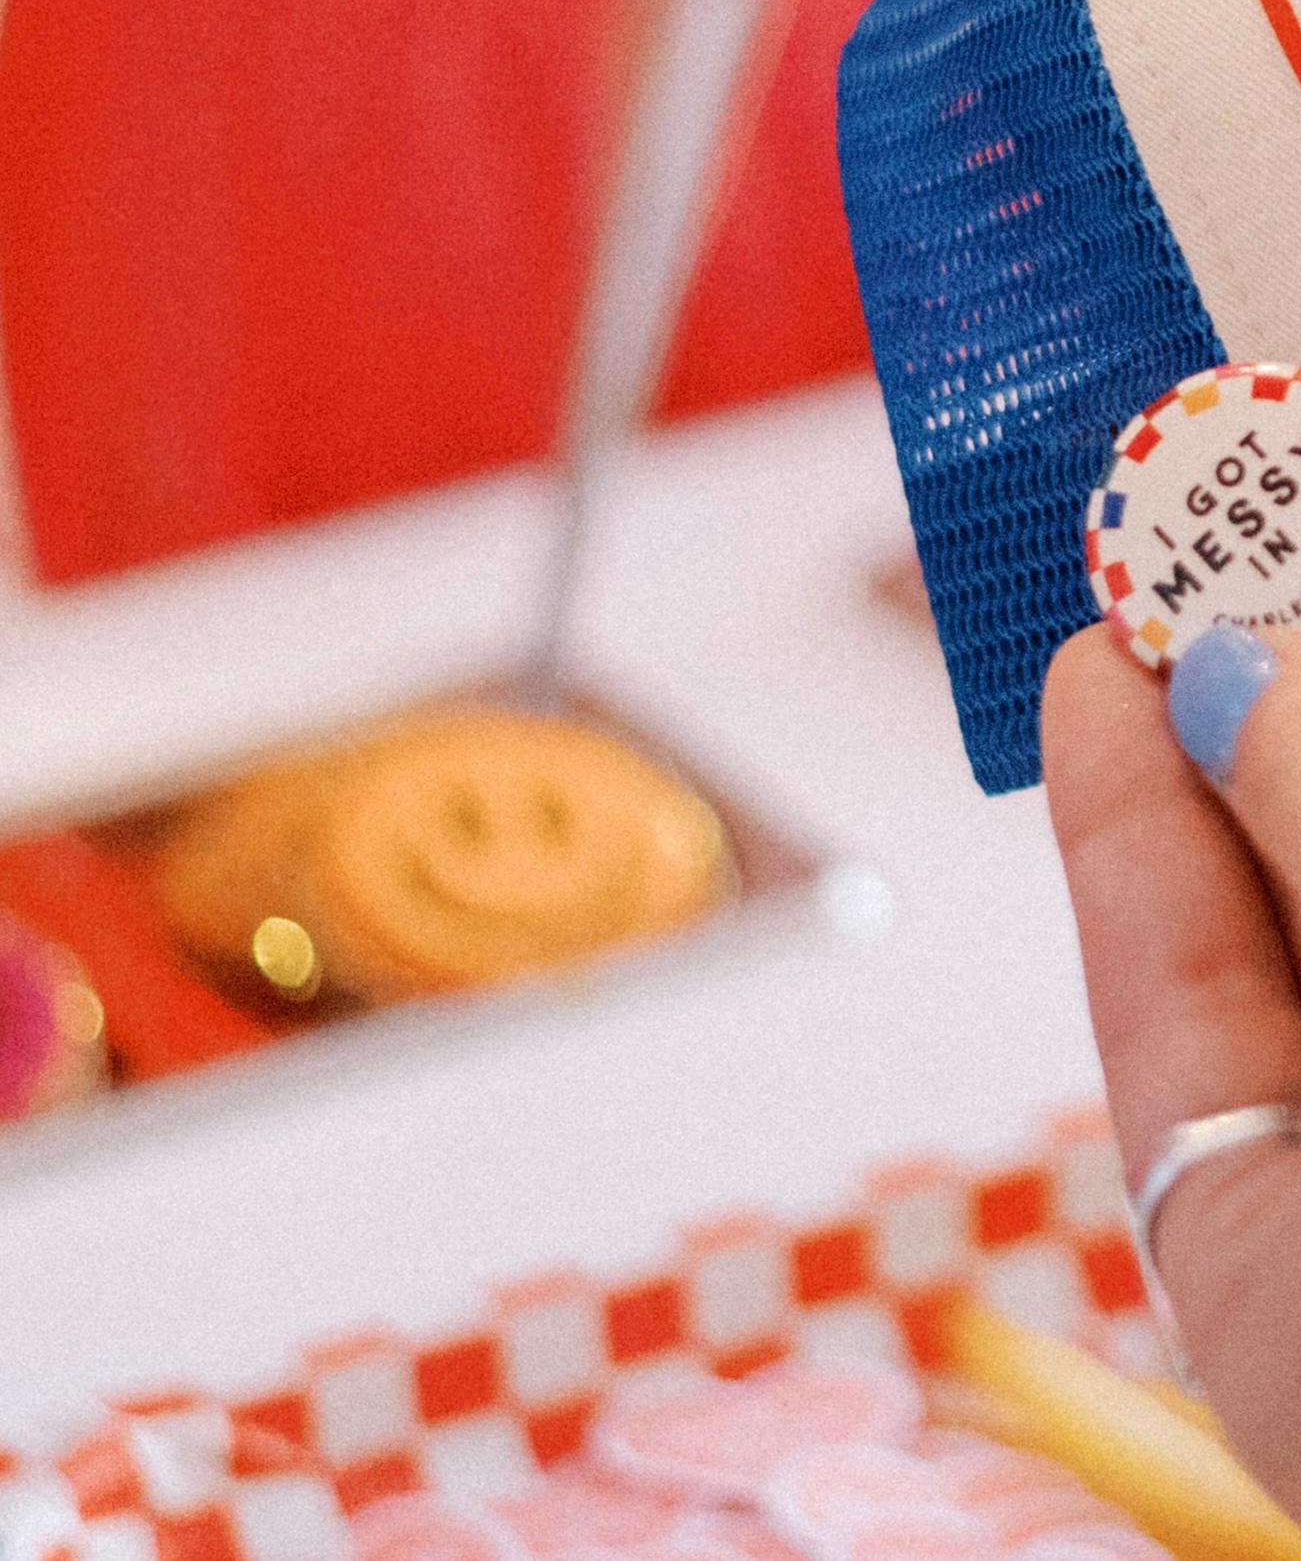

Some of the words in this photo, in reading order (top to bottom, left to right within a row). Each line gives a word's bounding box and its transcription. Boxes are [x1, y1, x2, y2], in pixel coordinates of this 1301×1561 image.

[1153, 524, 1177, 551] I
[1186, 430, 1267, 517] GOT
[1248, 529, 1298, 580] IN
